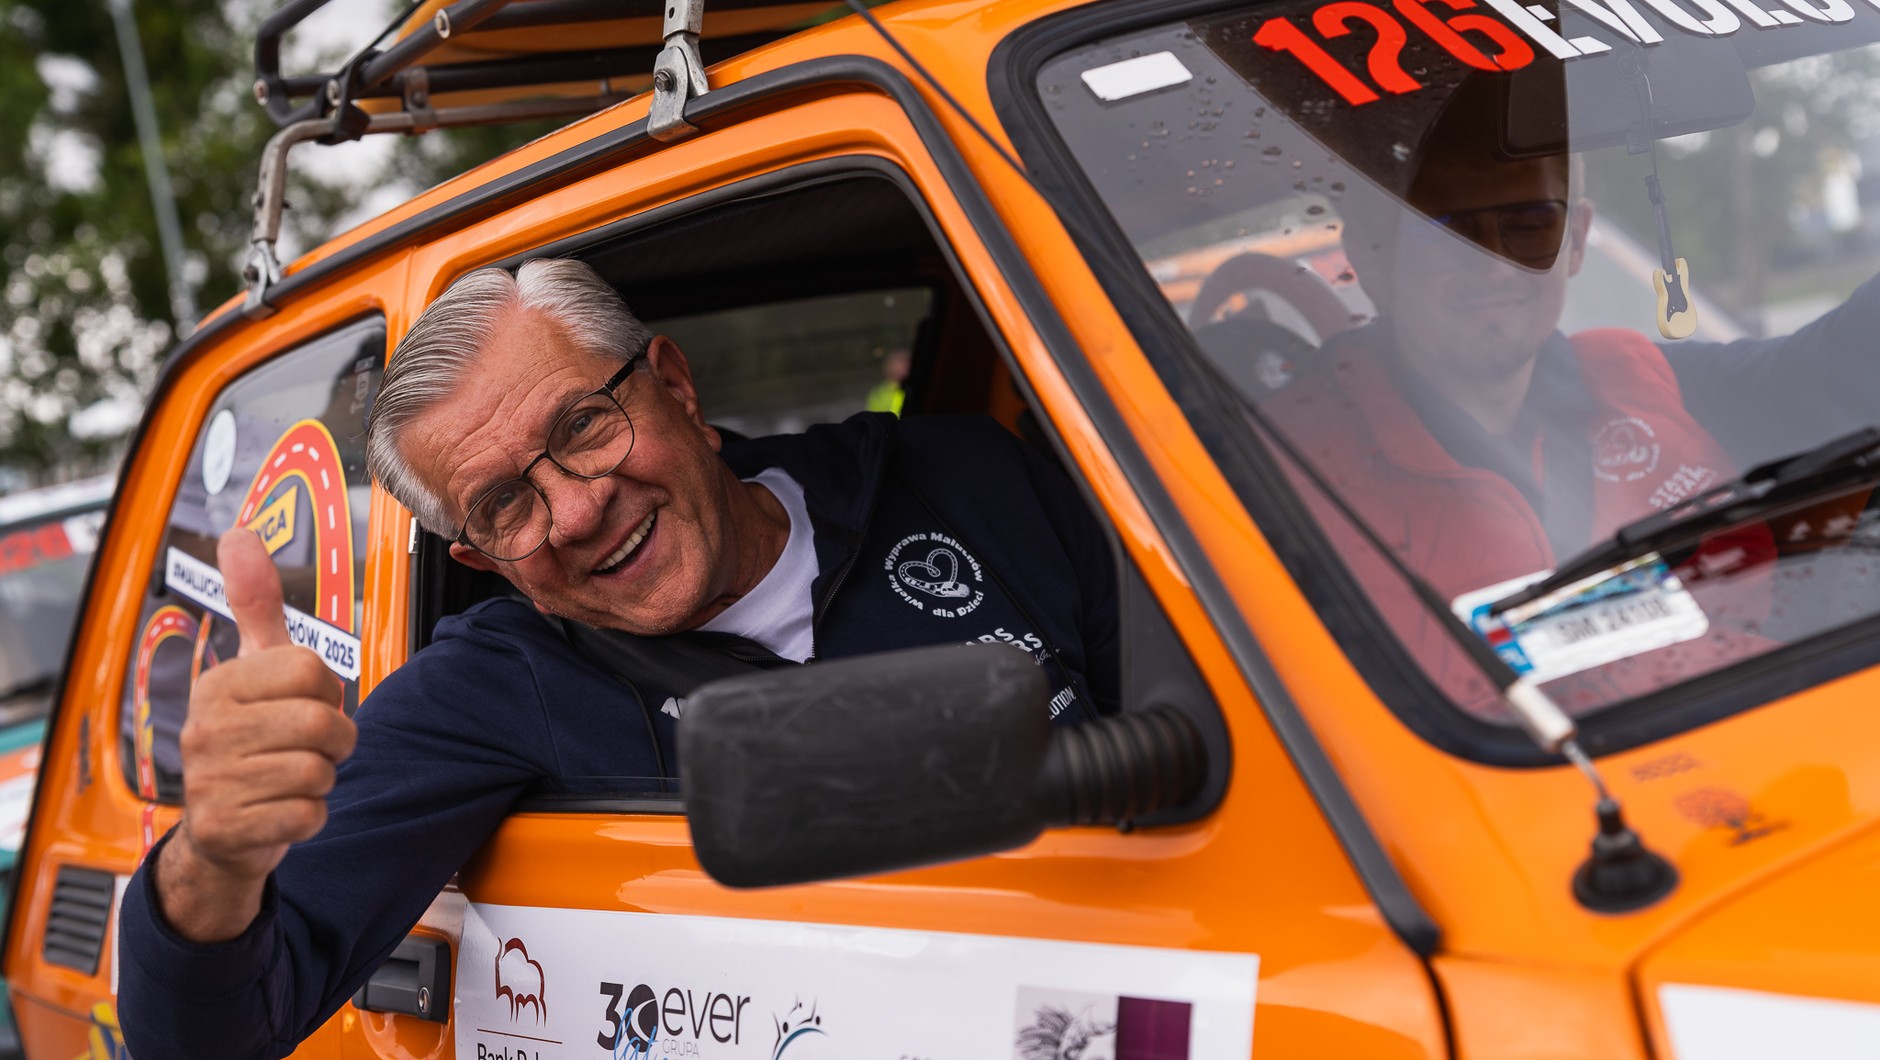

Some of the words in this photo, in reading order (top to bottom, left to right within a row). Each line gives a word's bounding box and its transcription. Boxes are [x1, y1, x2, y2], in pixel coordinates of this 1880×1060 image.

[885, 533, 926, 571] Wyprawa
[889, 574, 924, 610] Wielka
[956, 590, 985, 617] Dzieci
[932, 608, 955, 618] dla
[325, 637, 355, 670] 2025
[662, 987, 751, 1046] ever
[663, 1038, 700, 1058] GRUPA
